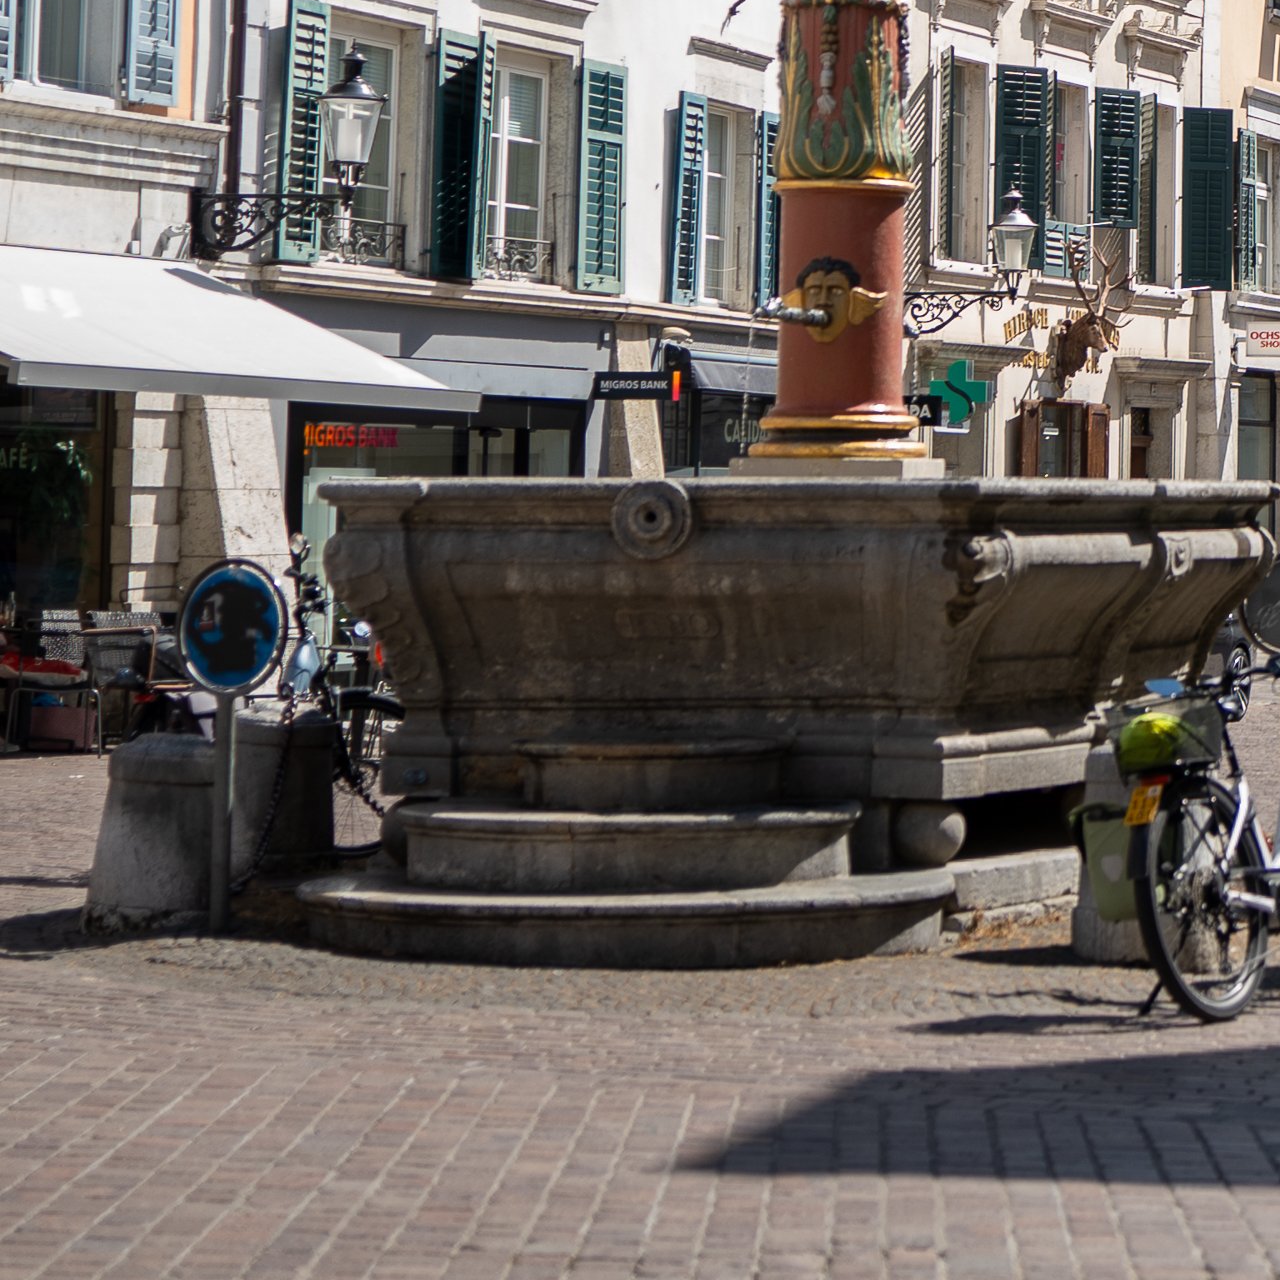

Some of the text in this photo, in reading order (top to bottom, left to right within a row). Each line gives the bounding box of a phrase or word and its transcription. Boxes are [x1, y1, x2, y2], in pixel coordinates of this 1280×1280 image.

[601, 380, 668, 390] MIGROS BANK
[358, 425, 400, 448] BANK
